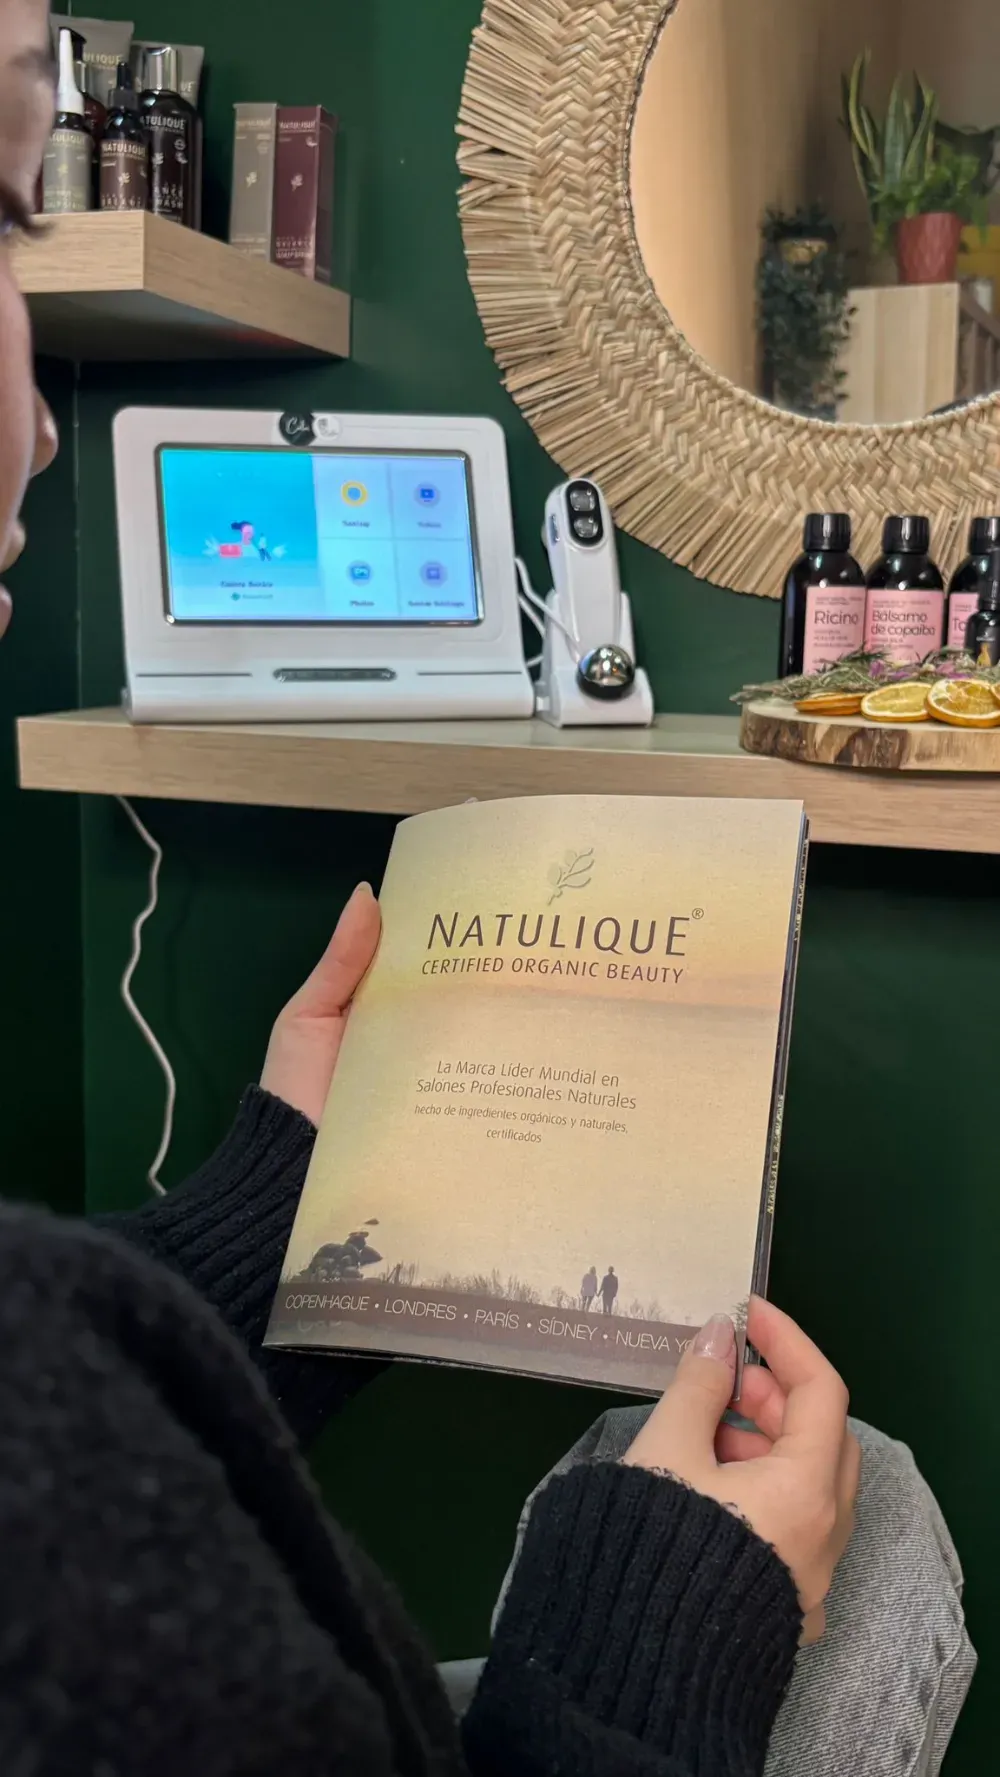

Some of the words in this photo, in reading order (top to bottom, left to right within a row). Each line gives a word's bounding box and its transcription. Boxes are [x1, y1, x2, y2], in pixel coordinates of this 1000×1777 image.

[140, 115, 186, 130] TULIQUE
[814, 610, 859, 625] Ricino
[871, 624, 886, 635] de
[888, 624, 935, 638] copaiba
[422, 957, 504, 975] CERTIFIED
[511, 957, 599, 978] ORGANIC
[606, 963, 684, 984] BEAUTY
[437, 1060, 452, 1074] La
[456, 1060, 496, 1076] Marca
[501, 1062, 535, 1078] Líder
[539, 1066, 596, 1085] Mundial
[601, 1074, 619, 1088] en
[416, 1077, 466, 1094] Salones
[470, 1080, 562, 1101] Profesionales
[567, 1088, 637, 1110] Naturales
[414, 1104, 442, 1115] hecho
[443, 1105, 456, 1116] de
[458, 1105, 518, 1121] ingredientes
[520, 1111, 567, 1126] orgánicos
[570, 1117, 577, 1128] y
[486, 1128, 542, 1144] certificados
[285, 1294, 370, 1311] COPENHAGUE
[384, 1299, 457, 1321] LONDRES
[474, 1308, 520, 1330] PARÍS
[537, 1316, 598, 1341] SÍDNEY
[615, 1329, 670, 1351] NUEVA
